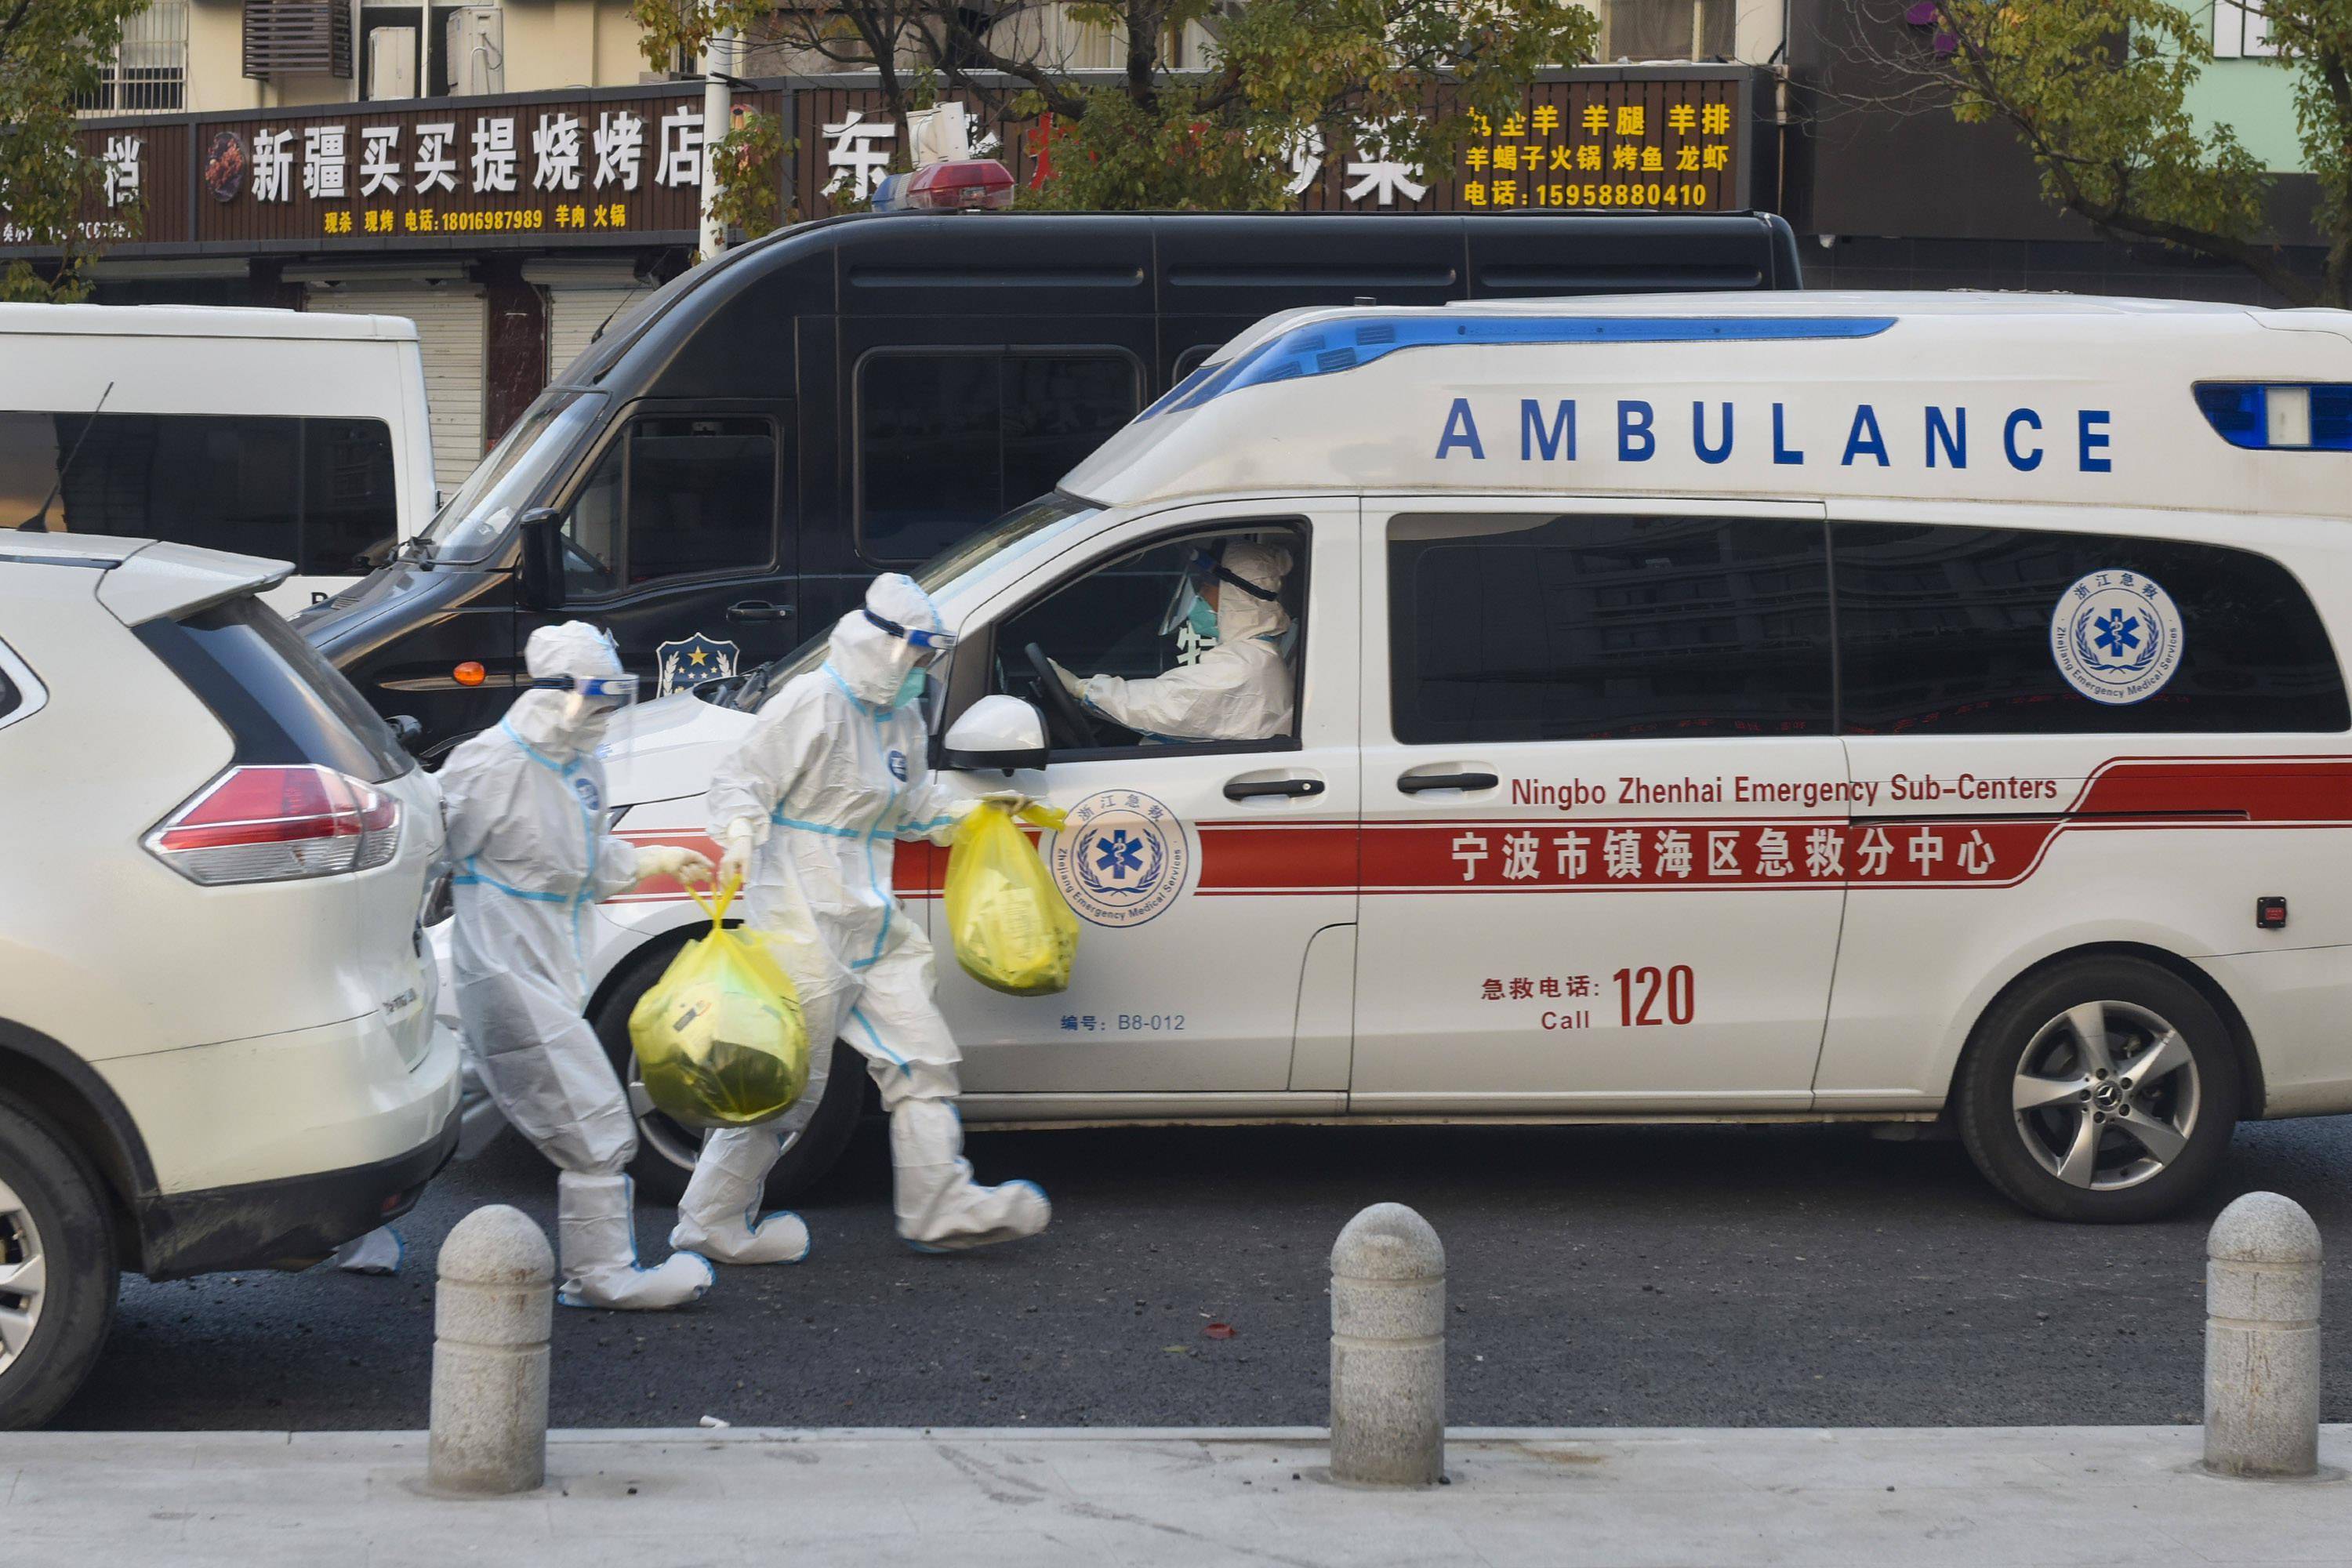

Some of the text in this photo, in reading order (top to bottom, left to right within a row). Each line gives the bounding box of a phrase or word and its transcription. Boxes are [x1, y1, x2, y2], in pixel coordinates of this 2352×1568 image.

[1582, 104, 1645, 136] 羊腿
[1668, 103, 1730, 135] 羊排
[251, 105, 704, 201] 新疆买买提烧烤店
[1465, 144, 1729, 172] 羊蝎子火锅 烤鱼 龙虾
[324, 210, 352, 233] 现杀
[364, 209, 394, 232] 现烤
[555, 204, 586, 228] 羊肉
[593, 203, 626, 227] 火锅
[1435, 397, 2111, 474] AMBULANCE
[2074, 573, 2158, 601] 浙江急救
[2071, 669, 2125, 699] Emergency
[2127, 670, 2163, 696] Medical
[2160, 627, 2178, 670] Services
[1077, 793, 1165, 822] 浙江急救
[1512, 773, 2058, 811] Ningbo Zhenhai Emergency Sub-Centers
[1451, 827, 1996, 881] 宁波市镇海区急救分中心
[1072, 891, 1125, 920] Emergency
[1128, 891, 1167, 919] Medical
[1163, 848, 1181, 893] Services
[1480, 964, 1695, 1027] 急救电话: 120
[1117, 1014, 1185, 1030] B8-012
[1541, 1010, 1591, 1031] Call
